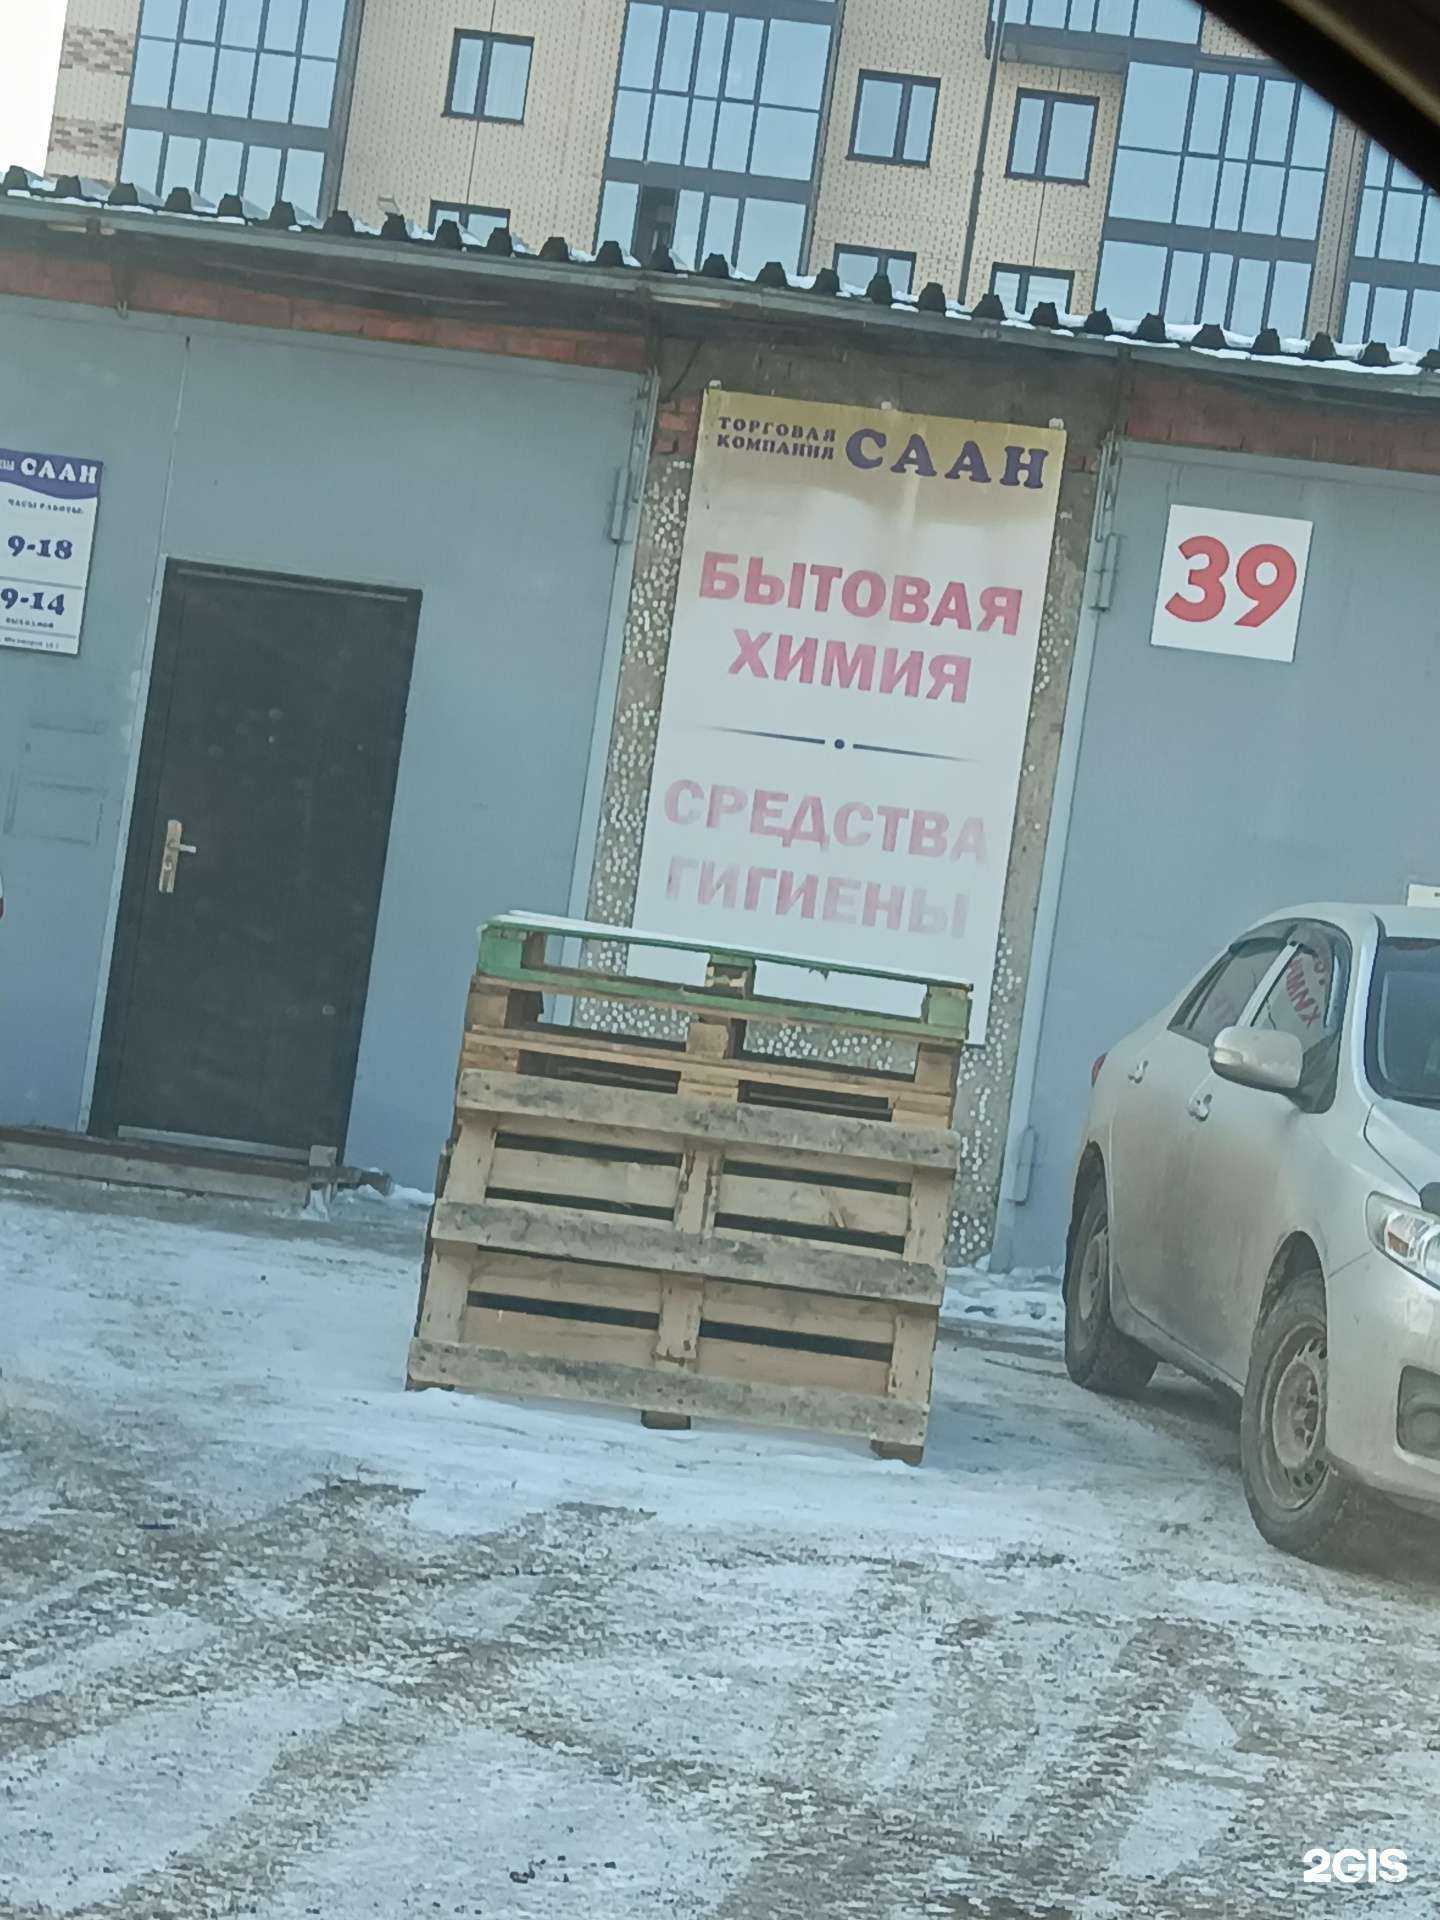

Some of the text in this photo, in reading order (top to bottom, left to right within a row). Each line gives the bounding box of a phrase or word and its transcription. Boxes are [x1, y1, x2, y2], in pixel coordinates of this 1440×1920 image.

[717, 434, 834, 460] КОМПАНИЯ
[718, 416, 836, 442] ТОРГОВАЯ
[845, 428, 1049, 489] СААН
[8, 535, 73, 560] 9-18
[1, 587, 65, 616] 9-14
[700, 551, 1023, 636] БЫТОВАЯ
[1165, 536, 1297, 628] 39
[728, 628, 972, 703] ХИМИЯ
[664, 779, 988, 864] СРЕДСТВА
[666, 855, 970, 939] ГИГИЕНЫ
